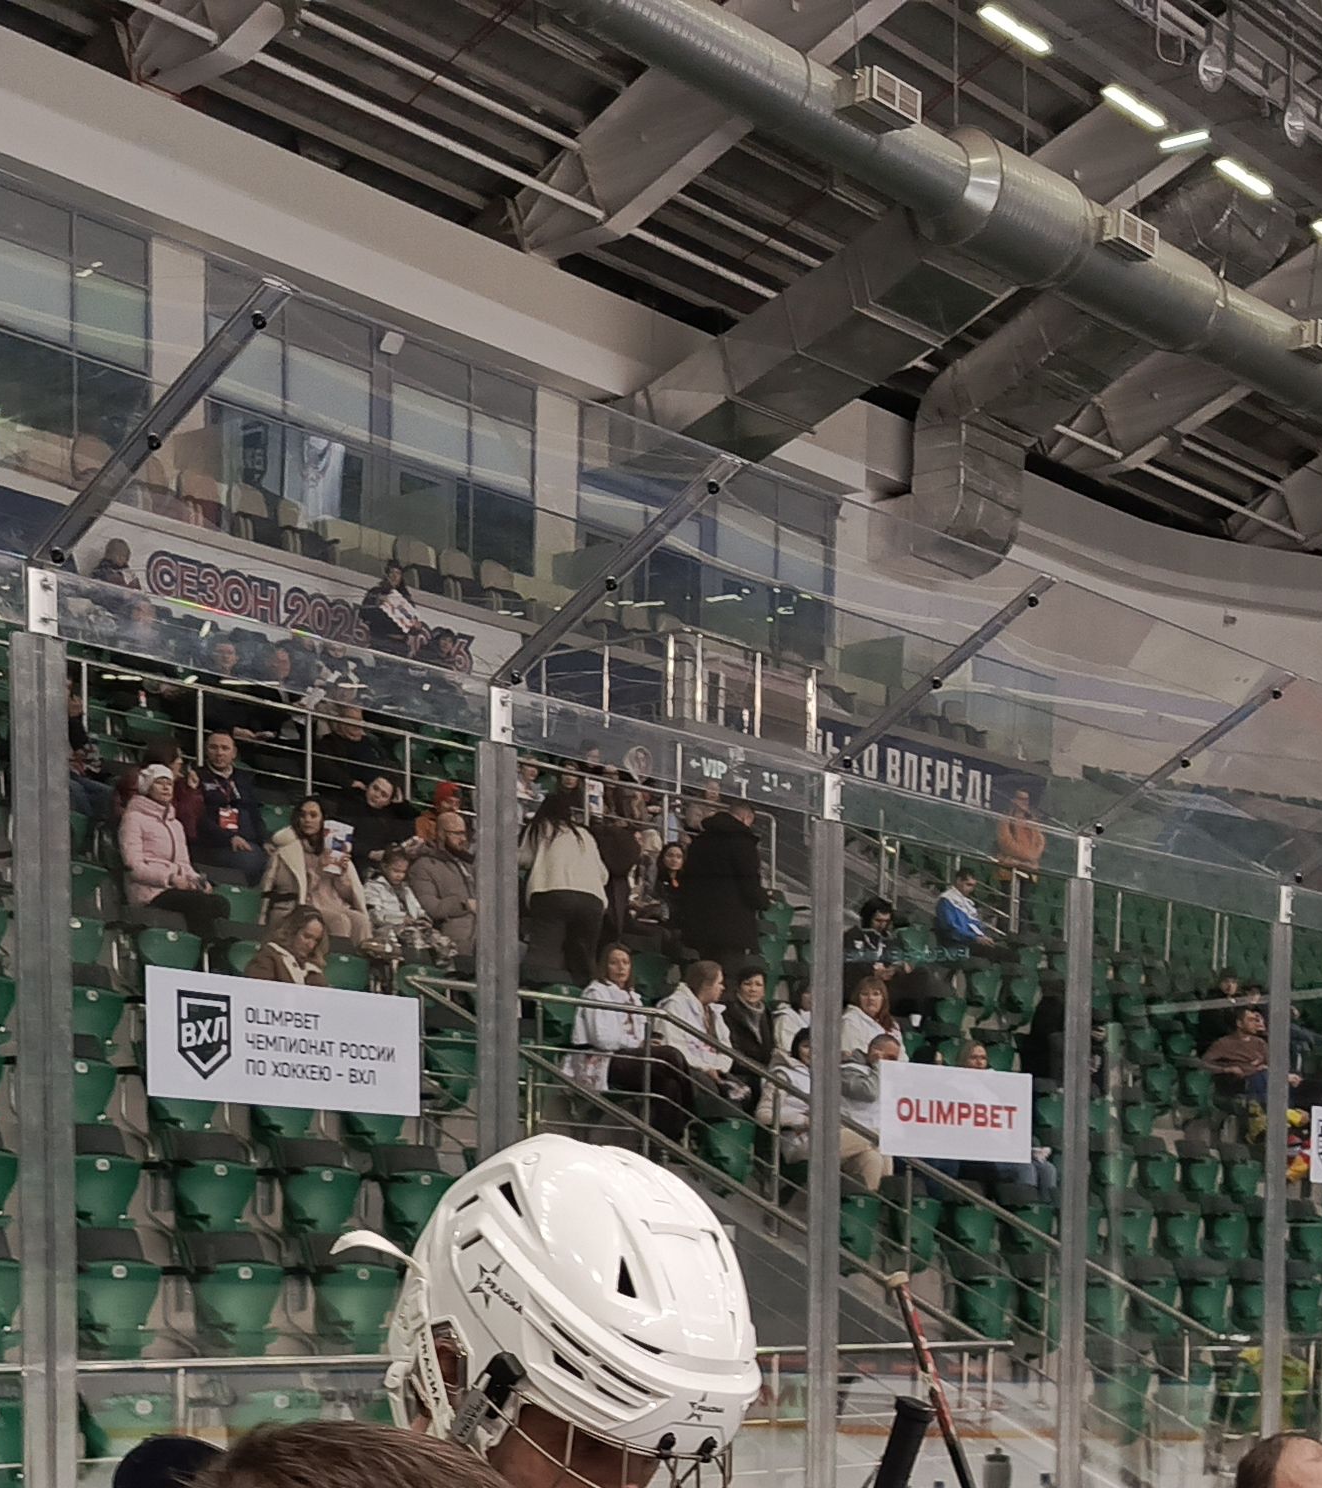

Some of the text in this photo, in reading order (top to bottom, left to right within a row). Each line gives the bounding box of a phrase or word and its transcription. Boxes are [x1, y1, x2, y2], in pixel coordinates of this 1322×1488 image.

[147, 550, 280, 626] СЕЗОН
[180, 1016, 228, 1049] ВХЛ
[245, 1007, 321, 1031] OLIMPBET
[245, 1033, 396, 1063] ЧЕМПИОНАТ РОССИИ
[245, 1059, 267, 1077] ПО
[271, 1061, 333, 1083] ХОККЕЮ
[348, 1068, 377, 1086] ВХЛ
[896, 1096, 1018, 1130] OLIMPBET
